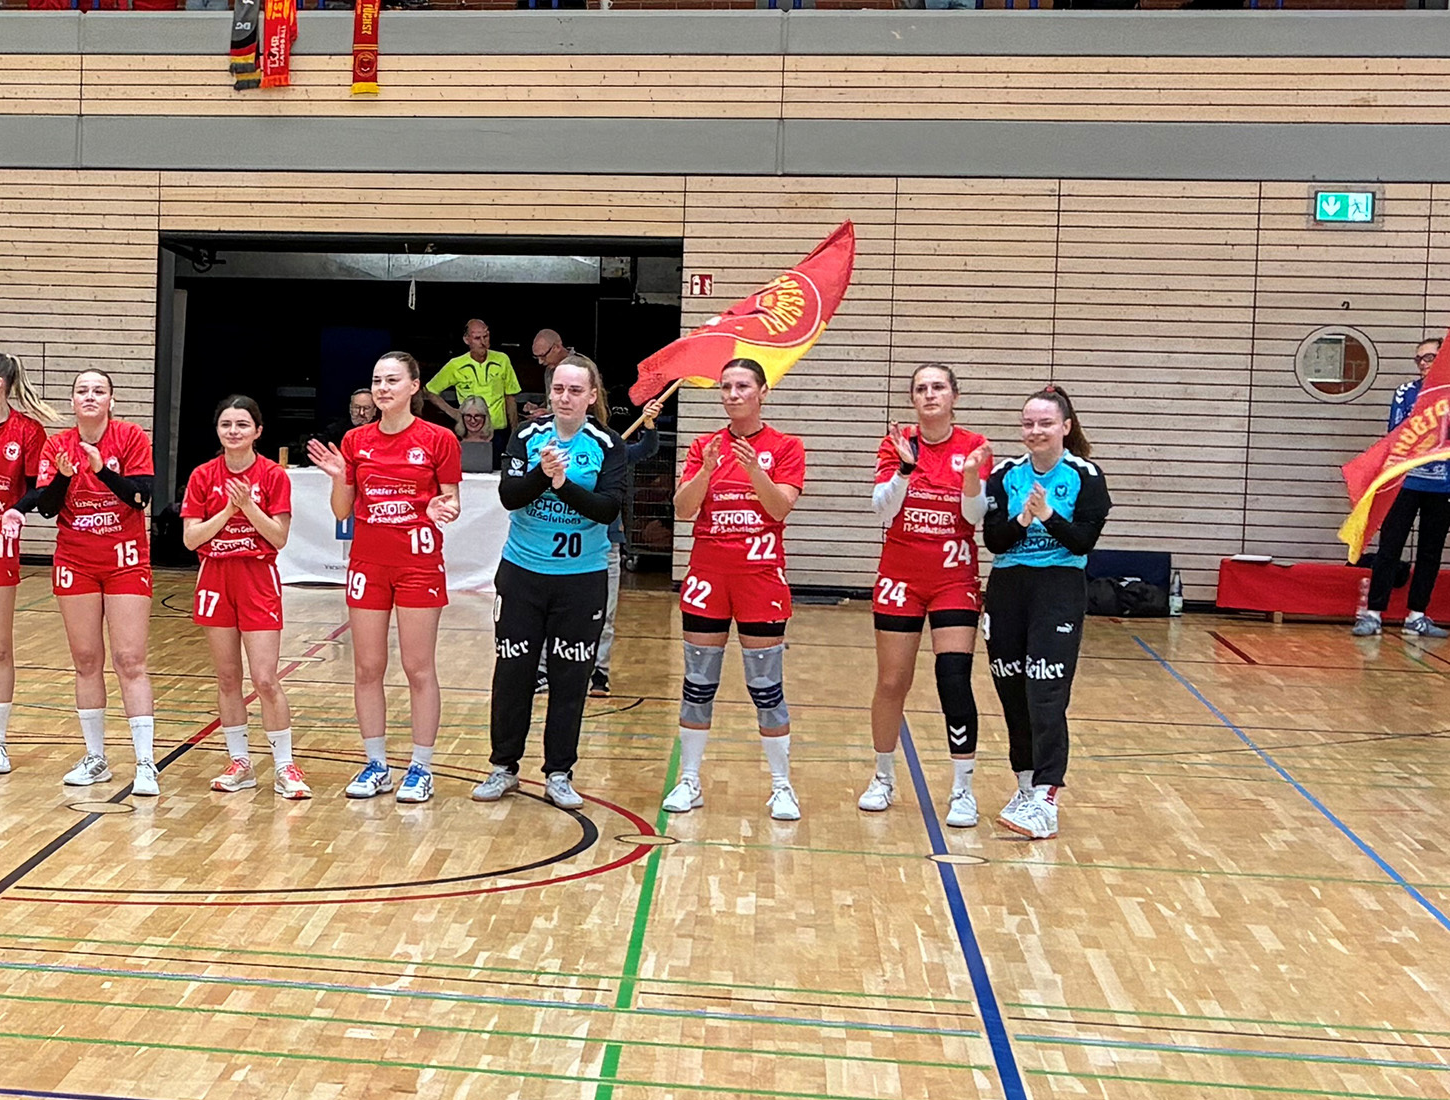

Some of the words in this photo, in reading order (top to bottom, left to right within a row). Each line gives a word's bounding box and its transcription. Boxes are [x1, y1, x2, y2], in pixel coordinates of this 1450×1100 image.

[711, 510, 764, 525] SCHOTEX
[904, 507, 957, 526] SCHOTEX
[113, 540, 138, 567] 15
[407, 527, 435, 555] 19
[551, 532, 582, 558] 20
[745, 532, 777, 561] 22
[943, 540, 971, 568] 24
[56, 566, 73, 589] 15
[348, 570, 366, 600] 19
[198, 589, 220, 617] 17
[682, 575, 712, 609] 22
[877, 577, 907, 607] 24
